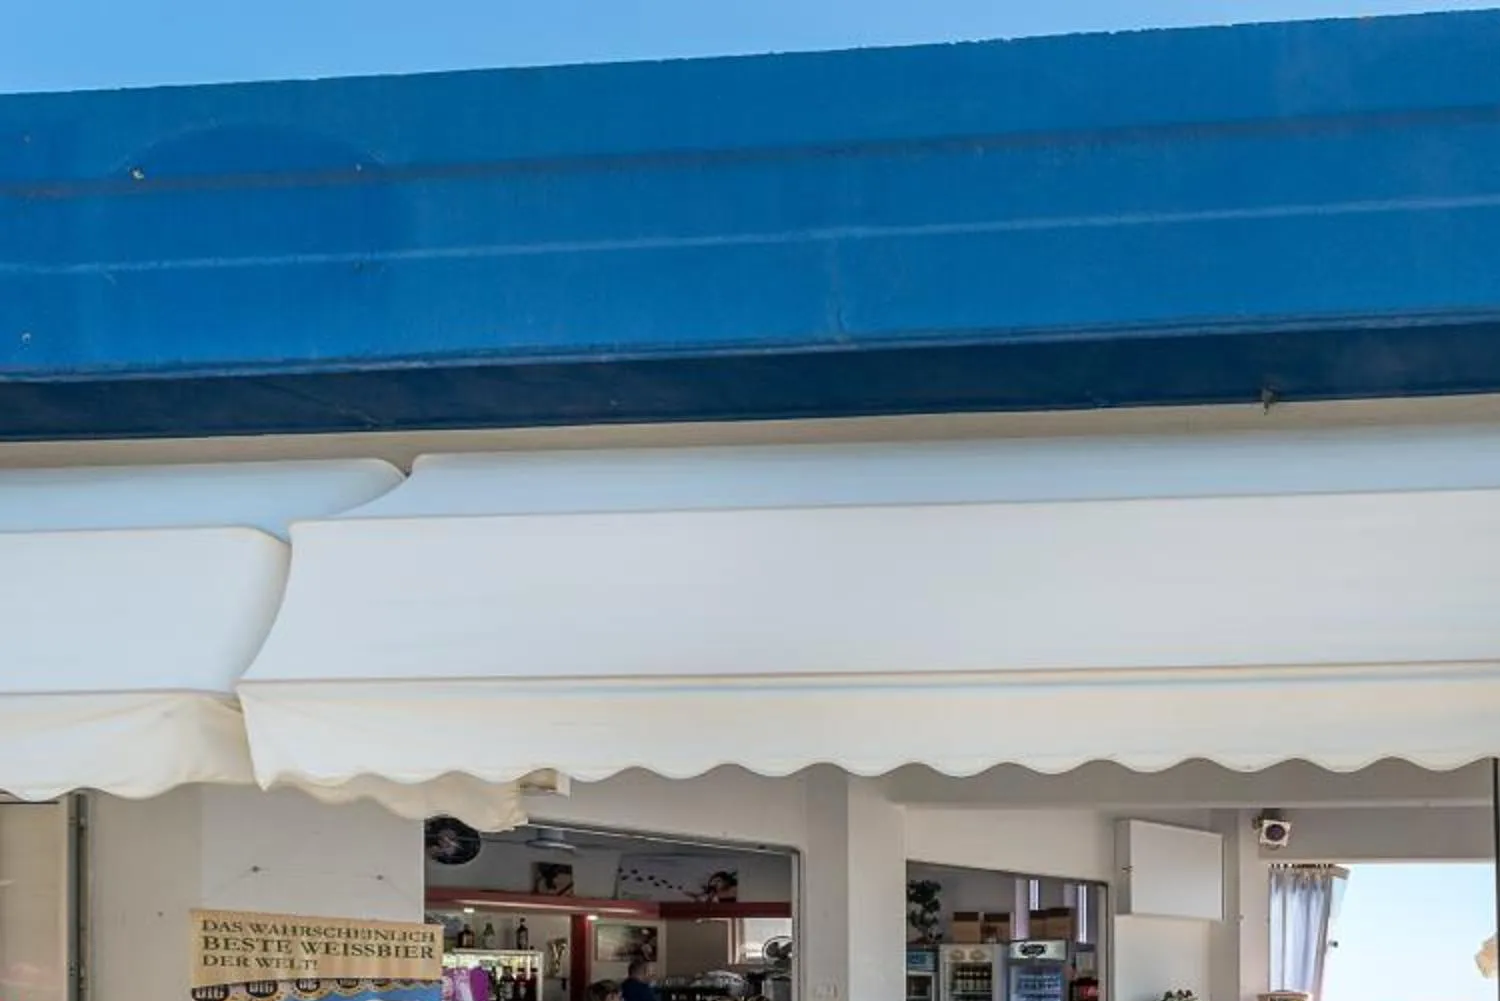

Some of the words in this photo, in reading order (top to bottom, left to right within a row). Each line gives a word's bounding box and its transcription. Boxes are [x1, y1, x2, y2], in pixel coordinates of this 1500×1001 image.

[203, 920, 243, 933] DAS
[203, 936, 293, 954] BESTE
[300, 940, 434, 959] WEISSBIER
[203, 955, 251, 968] DER
[256, 957, 318, 971] WELT!
